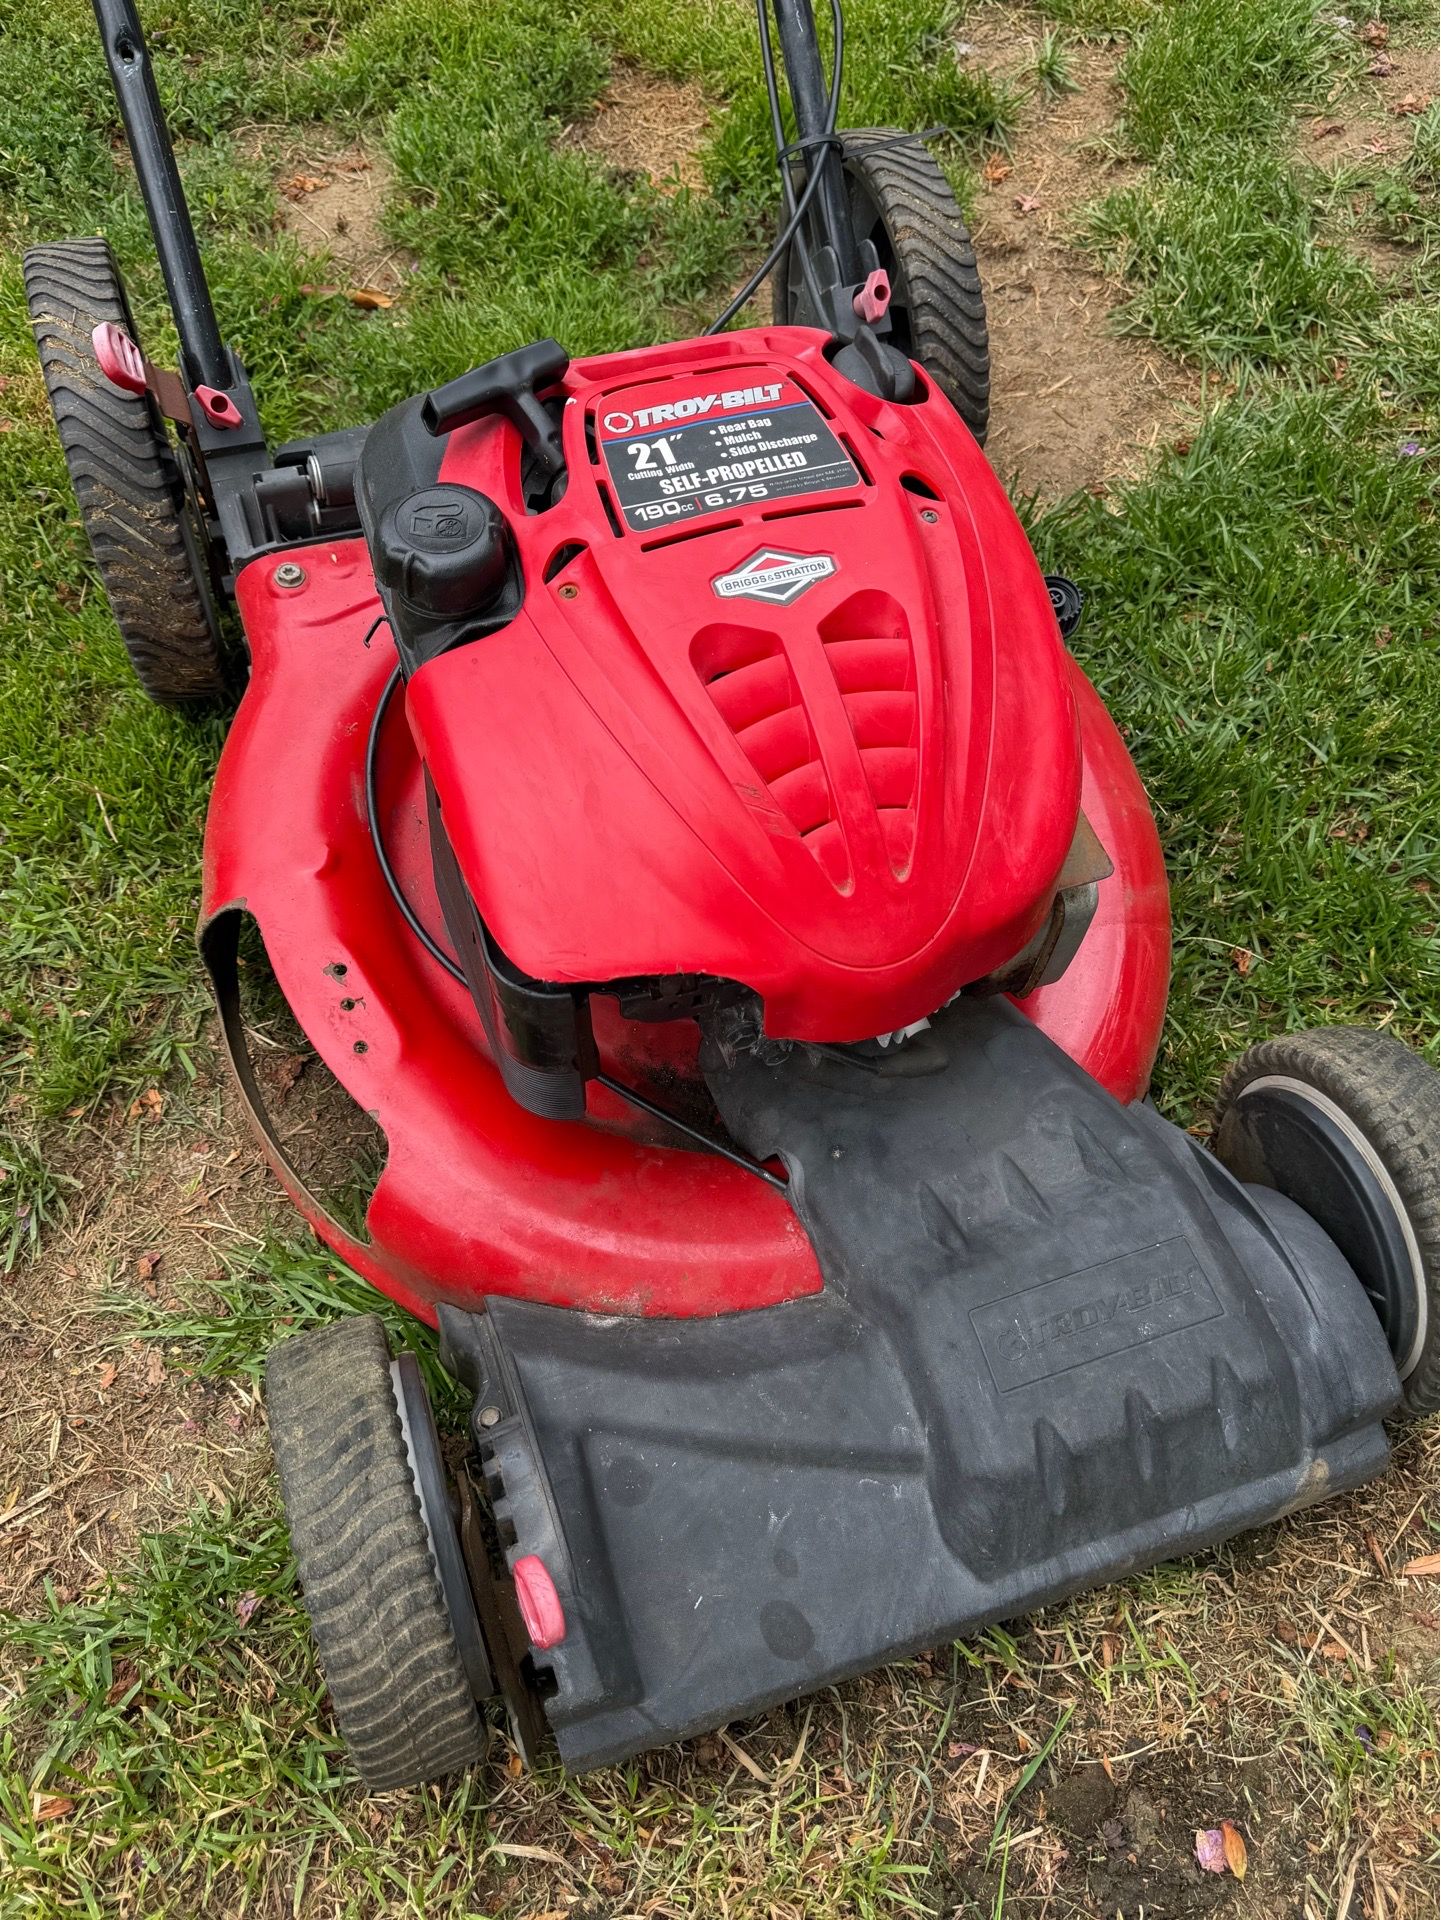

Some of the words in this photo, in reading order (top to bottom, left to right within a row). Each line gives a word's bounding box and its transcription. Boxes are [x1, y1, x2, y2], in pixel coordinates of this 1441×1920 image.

[633, 383, 783, 428] TROY-BILT
[718, 422, 746, 435] Rear
[747, 418, 772, 430] Bag
[723, 431, 762, 446] Mulch
[729, 444, 757, 457] Side
[757, 433, 818, 452] Discharge
[627, 469, 663, 481] Cutting
[665, 461, 695, 475] Width
[659, 451, 808, 495] SELF-PROPELLED
[704, 483, 769, 507] 6.75
